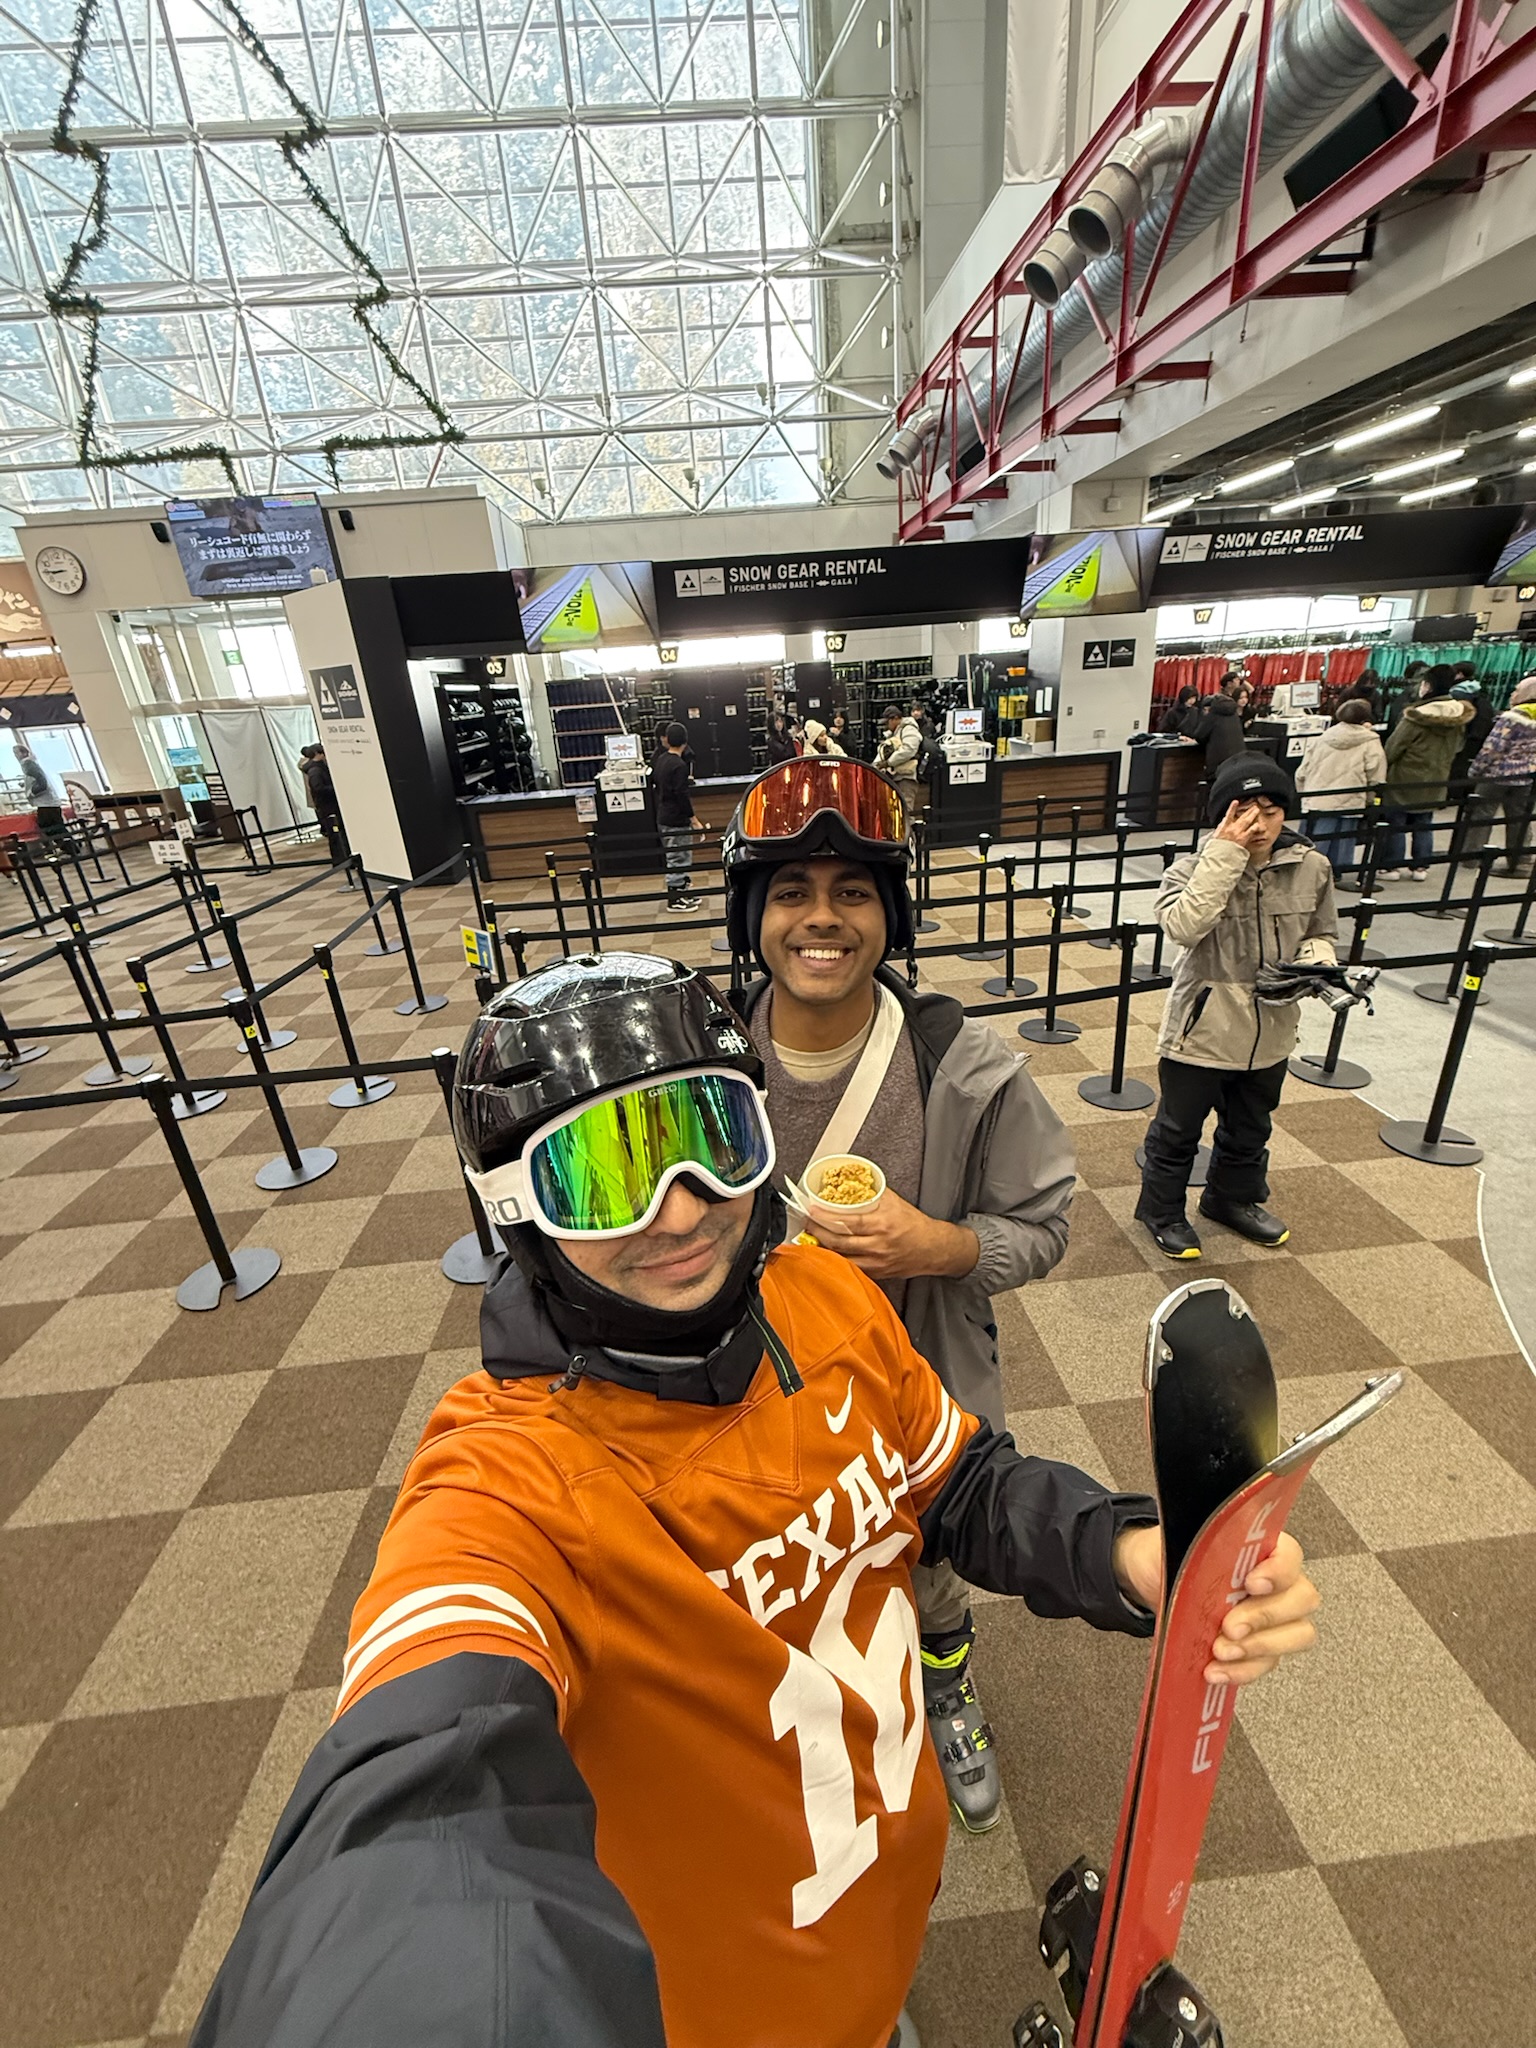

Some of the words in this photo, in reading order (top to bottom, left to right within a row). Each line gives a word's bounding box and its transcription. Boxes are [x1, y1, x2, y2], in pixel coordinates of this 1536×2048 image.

[1214, 531, 1258, 549] SNOW
[1260, 529, 1303, 546] GEAR
[1305, 525, 1364, 544] RENTAL
[1215, 550, 1246, 559] FISCHER
[1247, 549, 1267, 558] SNOW
[1267, 547, 1287, 556] BASE
[1307, 545, 1329, 553] GALA
[729, 564, 772, 583] SNOW
[777, 561, 820, 580] GEAR
[825, 557, 886, 576] RENTAL
[734, 583, 765, 593] FISCHER
[767, 581, 787, 591] SNOW
[789, 580, 809, 589] BASE
[830, 578, 853, 586] GALA
[1519, 586, 1536, 600] 09
[1195, 609, 1212, 622] 07
[1011, 622, 1027, 637] 06
[826, 636, 843, 650] 05
[660, 649, 677, 662] 04
[486, 661, 504, 675] 03
[648, 1083, 678, 1098] GIRO
[484, 1196, 523, 1223] RO
[1191, 1496, 1282, 1775] FISER
